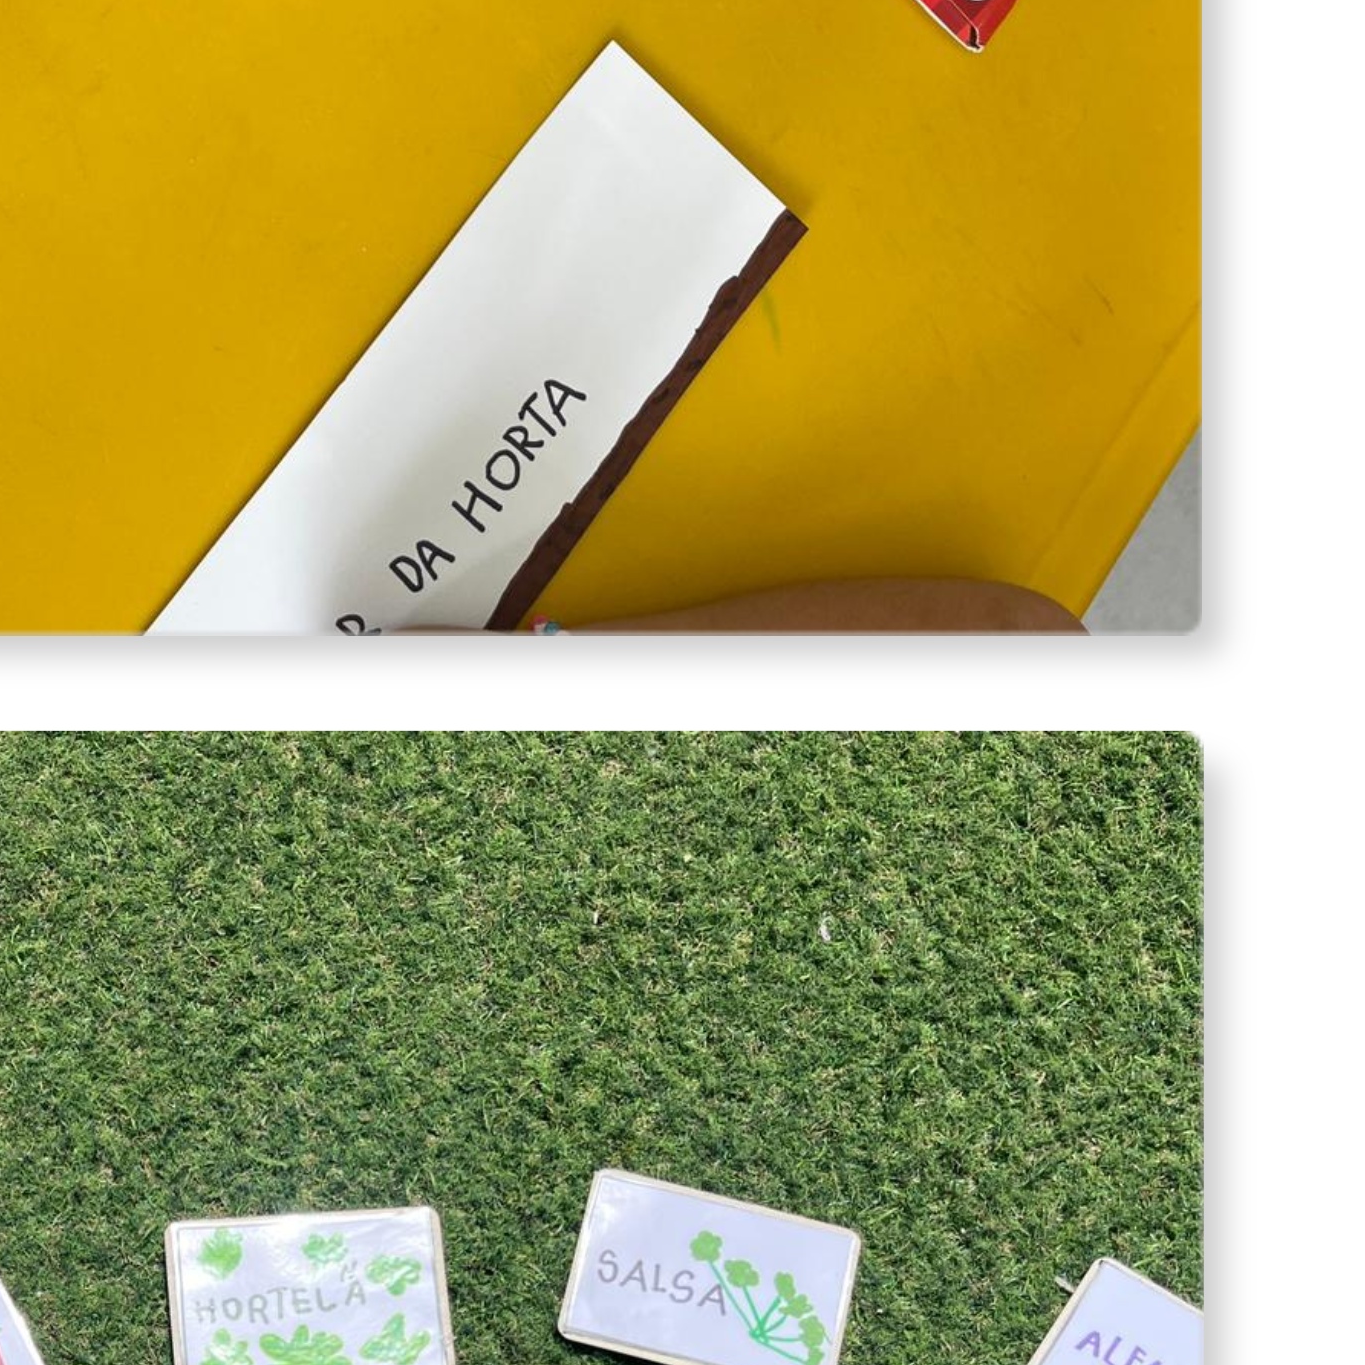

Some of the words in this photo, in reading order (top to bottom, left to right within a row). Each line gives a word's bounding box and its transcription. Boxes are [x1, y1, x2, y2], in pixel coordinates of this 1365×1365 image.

[388, 539, 457, 593] DA
[451, 378, 588, 533] HORTA
[194, 1260, 366, 1325] HORTELÃ
[597, 1249, 727, 1317] SALSA
